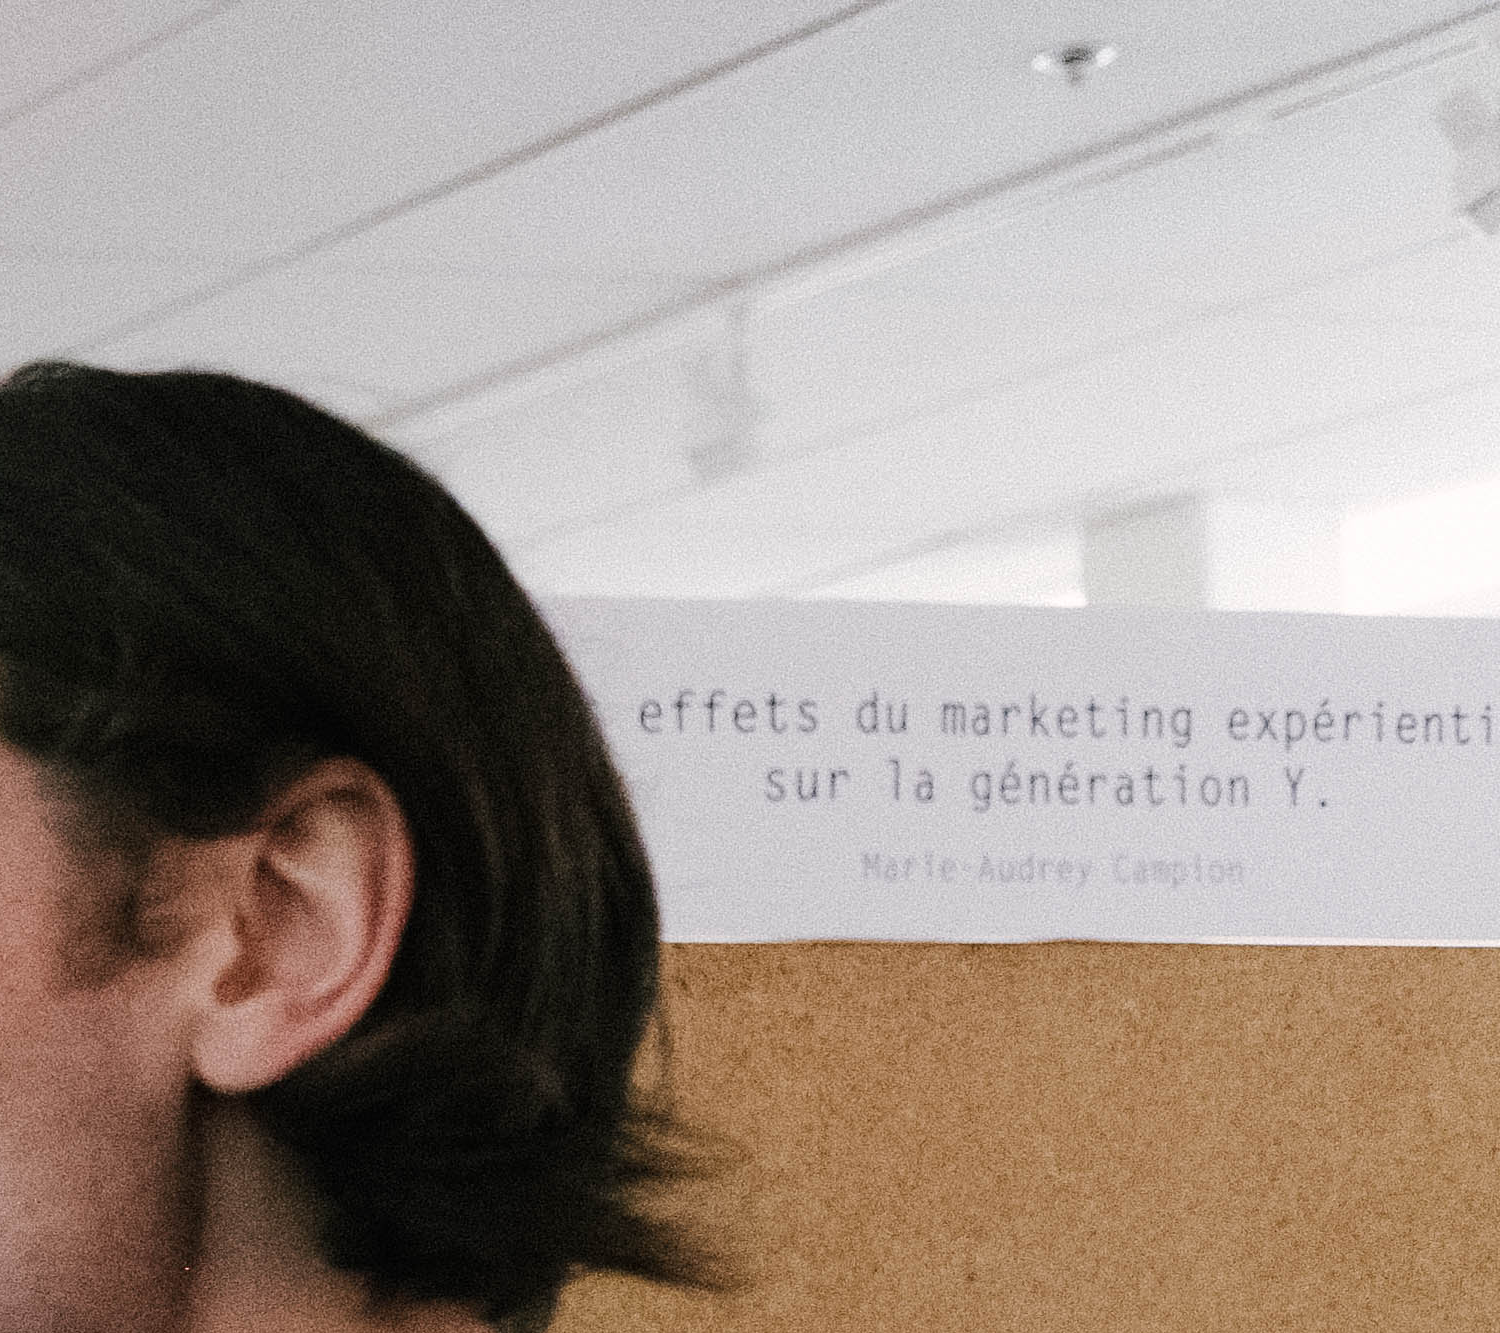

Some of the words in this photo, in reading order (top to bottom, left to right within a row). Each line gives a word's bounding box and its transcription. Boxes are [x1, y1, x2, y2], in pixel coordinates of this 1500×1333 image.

[637, 688, 820, 735] effets
[854, 691, 909, 736] du
[940, 693, 1194, 750] marketing
[764, 767, 851, 804] sur
[888, 758, 936, 804] la
[969, 760, 1251, 812] génération
[1283, 766, 1331, 811] Y.
[860, 851, 1093, 890] Marie-Audrey
[1112, 853, 1245, 890] Campion
